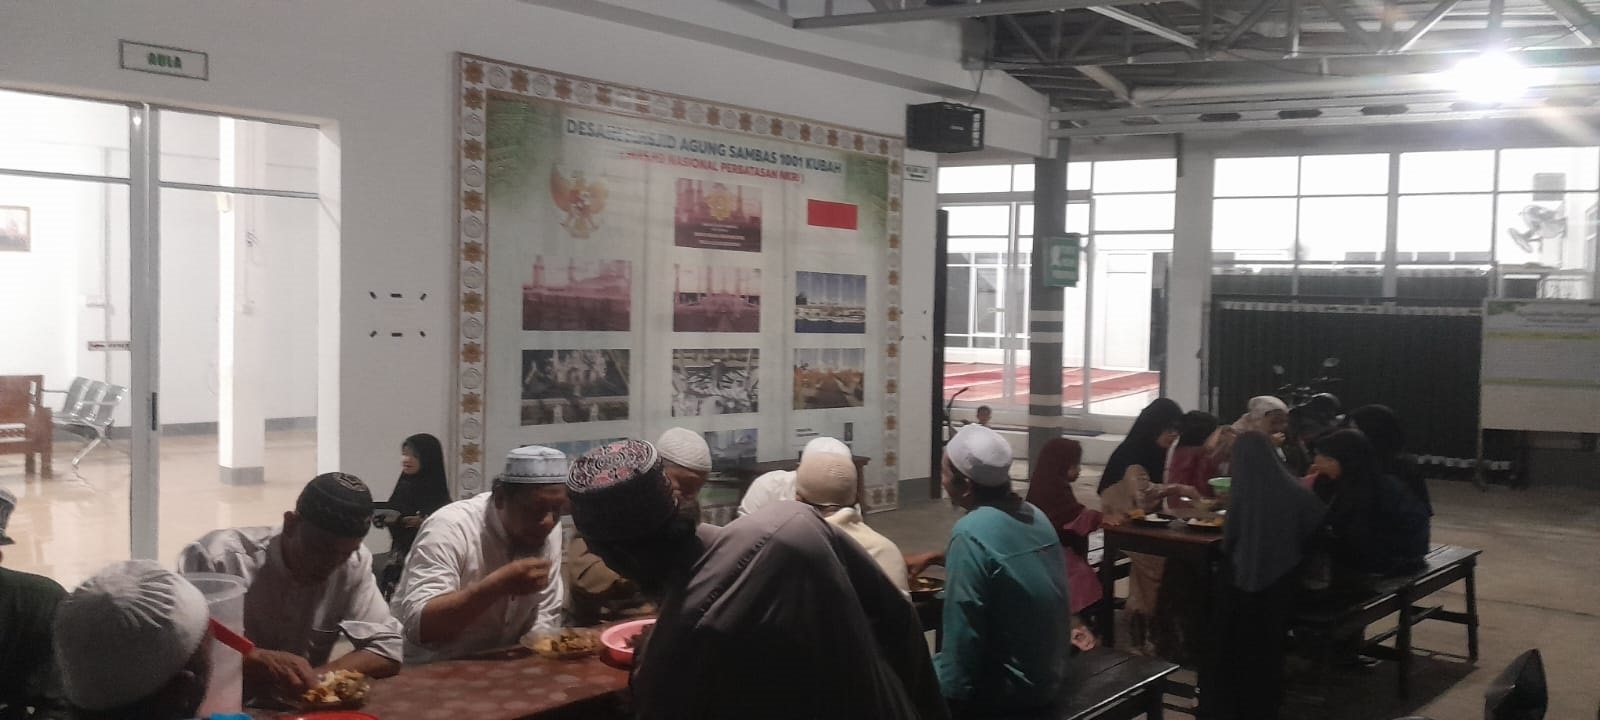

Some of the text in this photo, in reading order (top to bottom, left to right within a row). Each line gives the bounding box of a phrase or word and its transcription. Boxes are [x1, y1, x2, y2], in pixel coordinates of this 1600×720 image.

[147, 52, 182, 69] AULA
[668, 154, 719, 172] NASIONAL
[720, 161, 778, 179] PERBATASAN
[680, 137, 727, 156] AGUNG
[728, 145, 777, 164] SAMBAS
[780, 153, 804, 169] 1001
[805, 157, 842, 174] KUBAH
